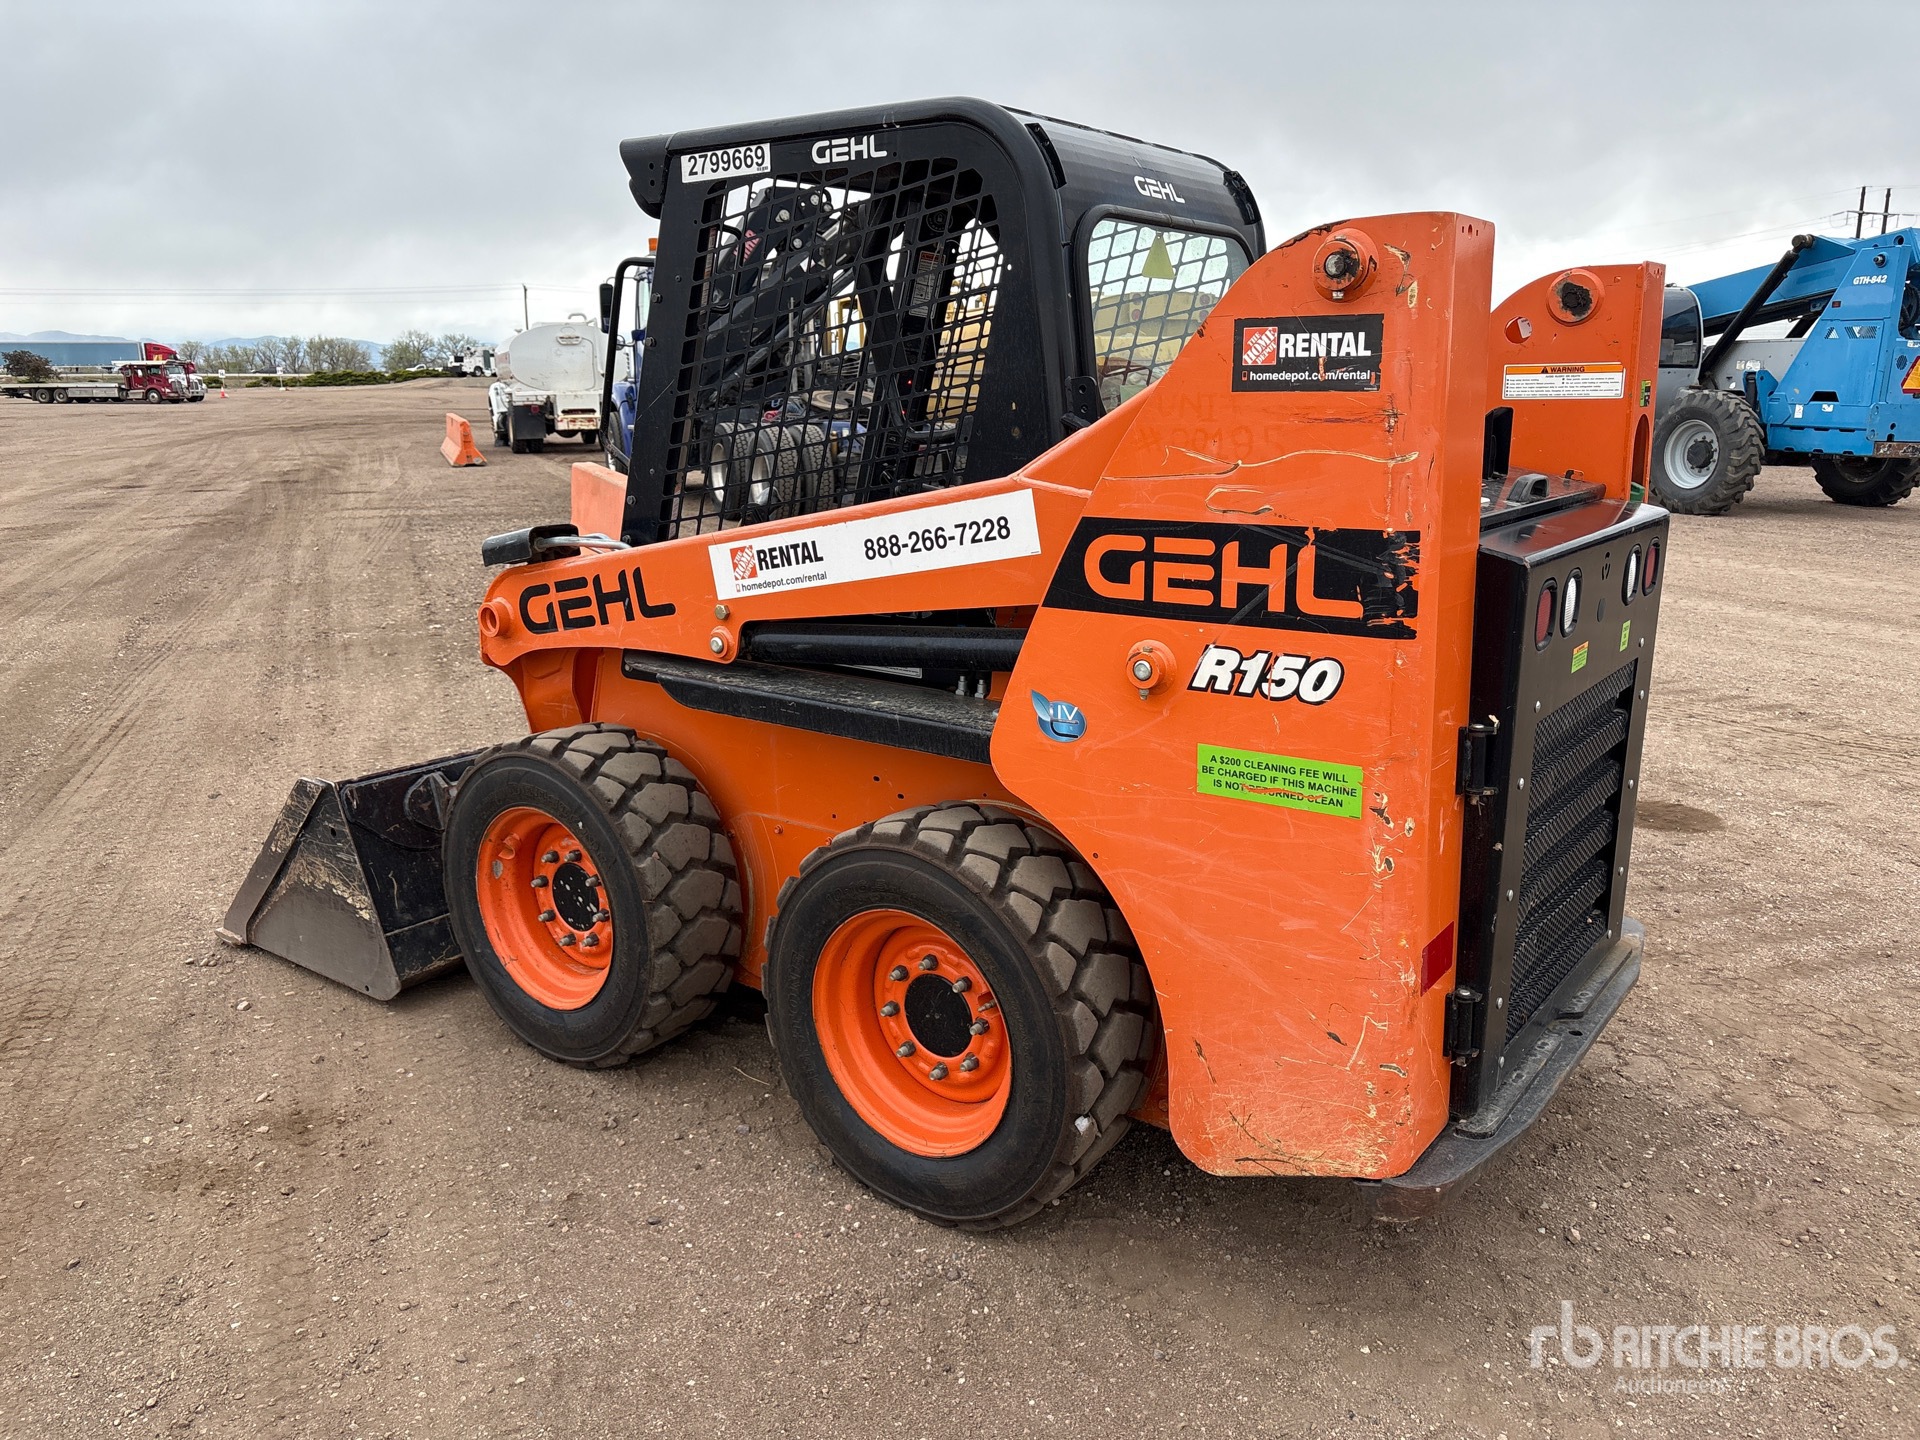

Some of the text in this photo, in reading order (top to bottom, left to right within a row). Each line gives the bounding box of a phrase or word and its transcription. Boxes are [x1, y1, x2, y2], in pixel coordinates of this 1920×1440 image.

[687, 145, 766, 176] 2799669
[811, 134, 888, 164] GEHL
[1133, 175, 1186, 204] GEHL
[1853, 275, 1888, 285] GTH-842
[1243, 328, 1277, 364] HOME
[1247, 331, 1262, 347] THE
[1256, 341, 1277, 365] DEPOT
[1279, 331, 1372, 358] RENTAL
[864, 516, 1011, 560] 888-266-7228
[734, 545, 753, 580] HOME
[756, 540, 825, 571] RENTAL
[741, 571, 827, 592] homedepot.com/rental
[1083, 534, 1364, 619] GEHL
[519, 566, 676, 635] GEHL
[1187, 644, 1345, 706] R150
[1202, 765, 1358, 797] BE CHARGED IF THIS MACHINE
[1210, 754, 1349, 783] A $200 CLEANING FEE WILL
[1213, 779, 1223, 788] IS
[1225, 781, 1244, 792] NOT
[1307, 794, 1343, 808] CLEAN
